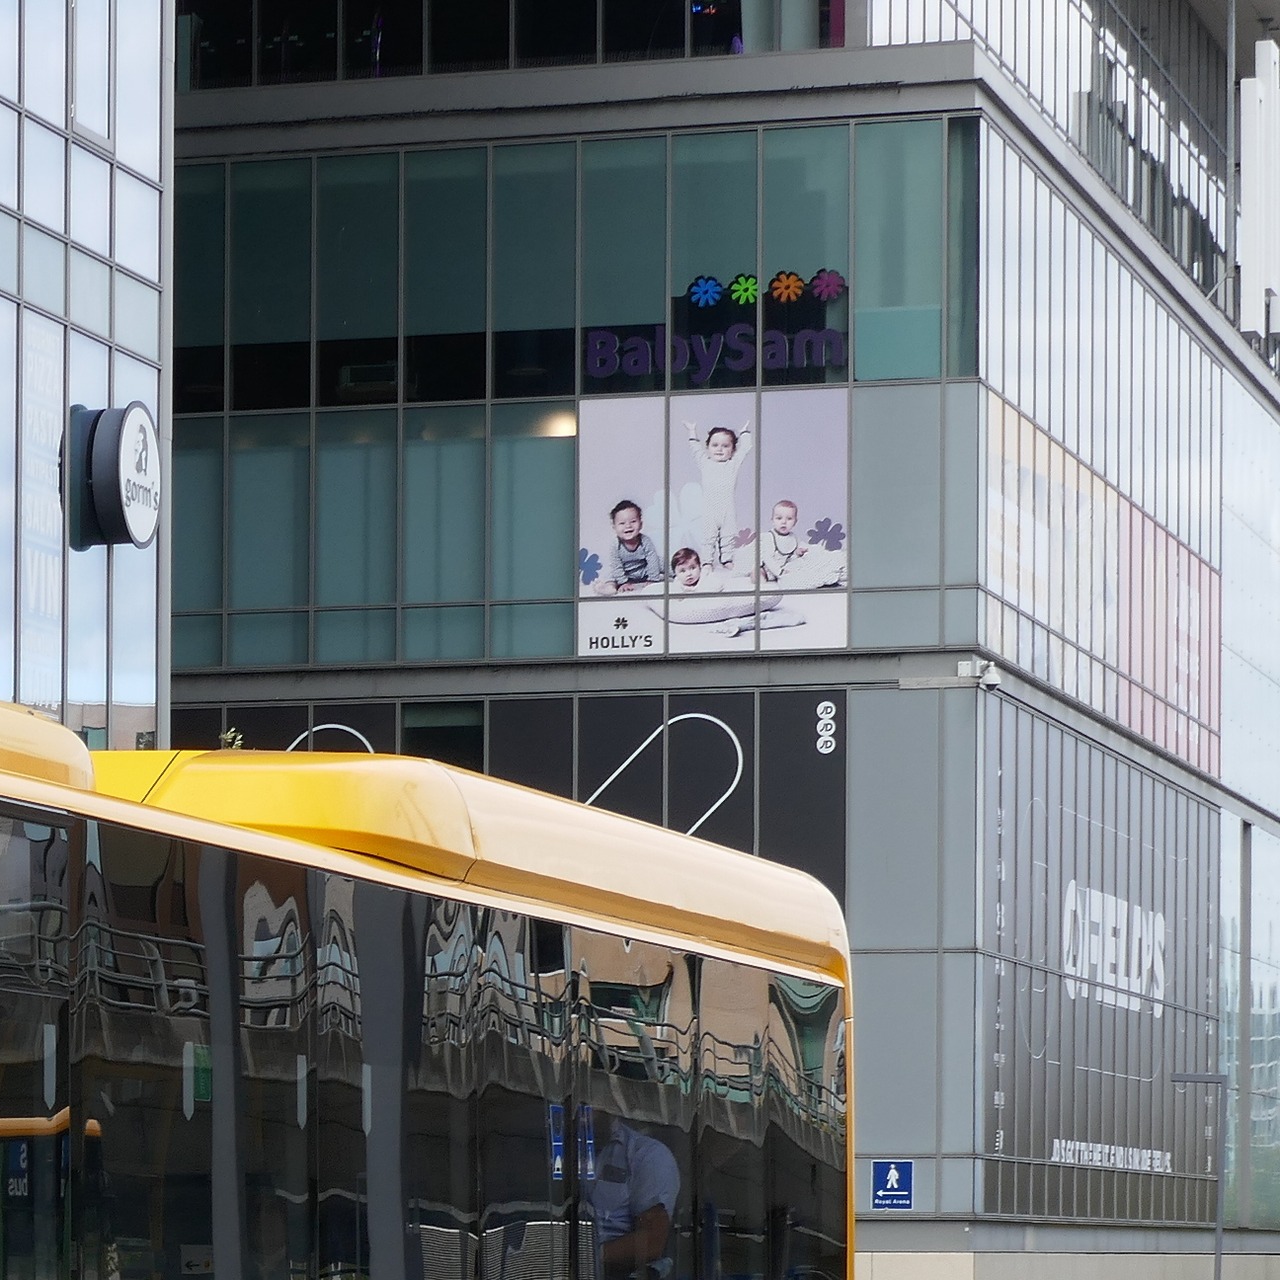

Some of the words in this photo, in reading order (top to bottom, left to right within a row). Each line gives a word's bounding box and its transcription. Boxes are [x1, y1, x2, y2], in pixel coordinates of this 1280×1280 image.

[586, 324, 846, 384] BabySam
[124, 476, 160, 511] gorm's
[589, 635, 653, 649] HOLLY'S
